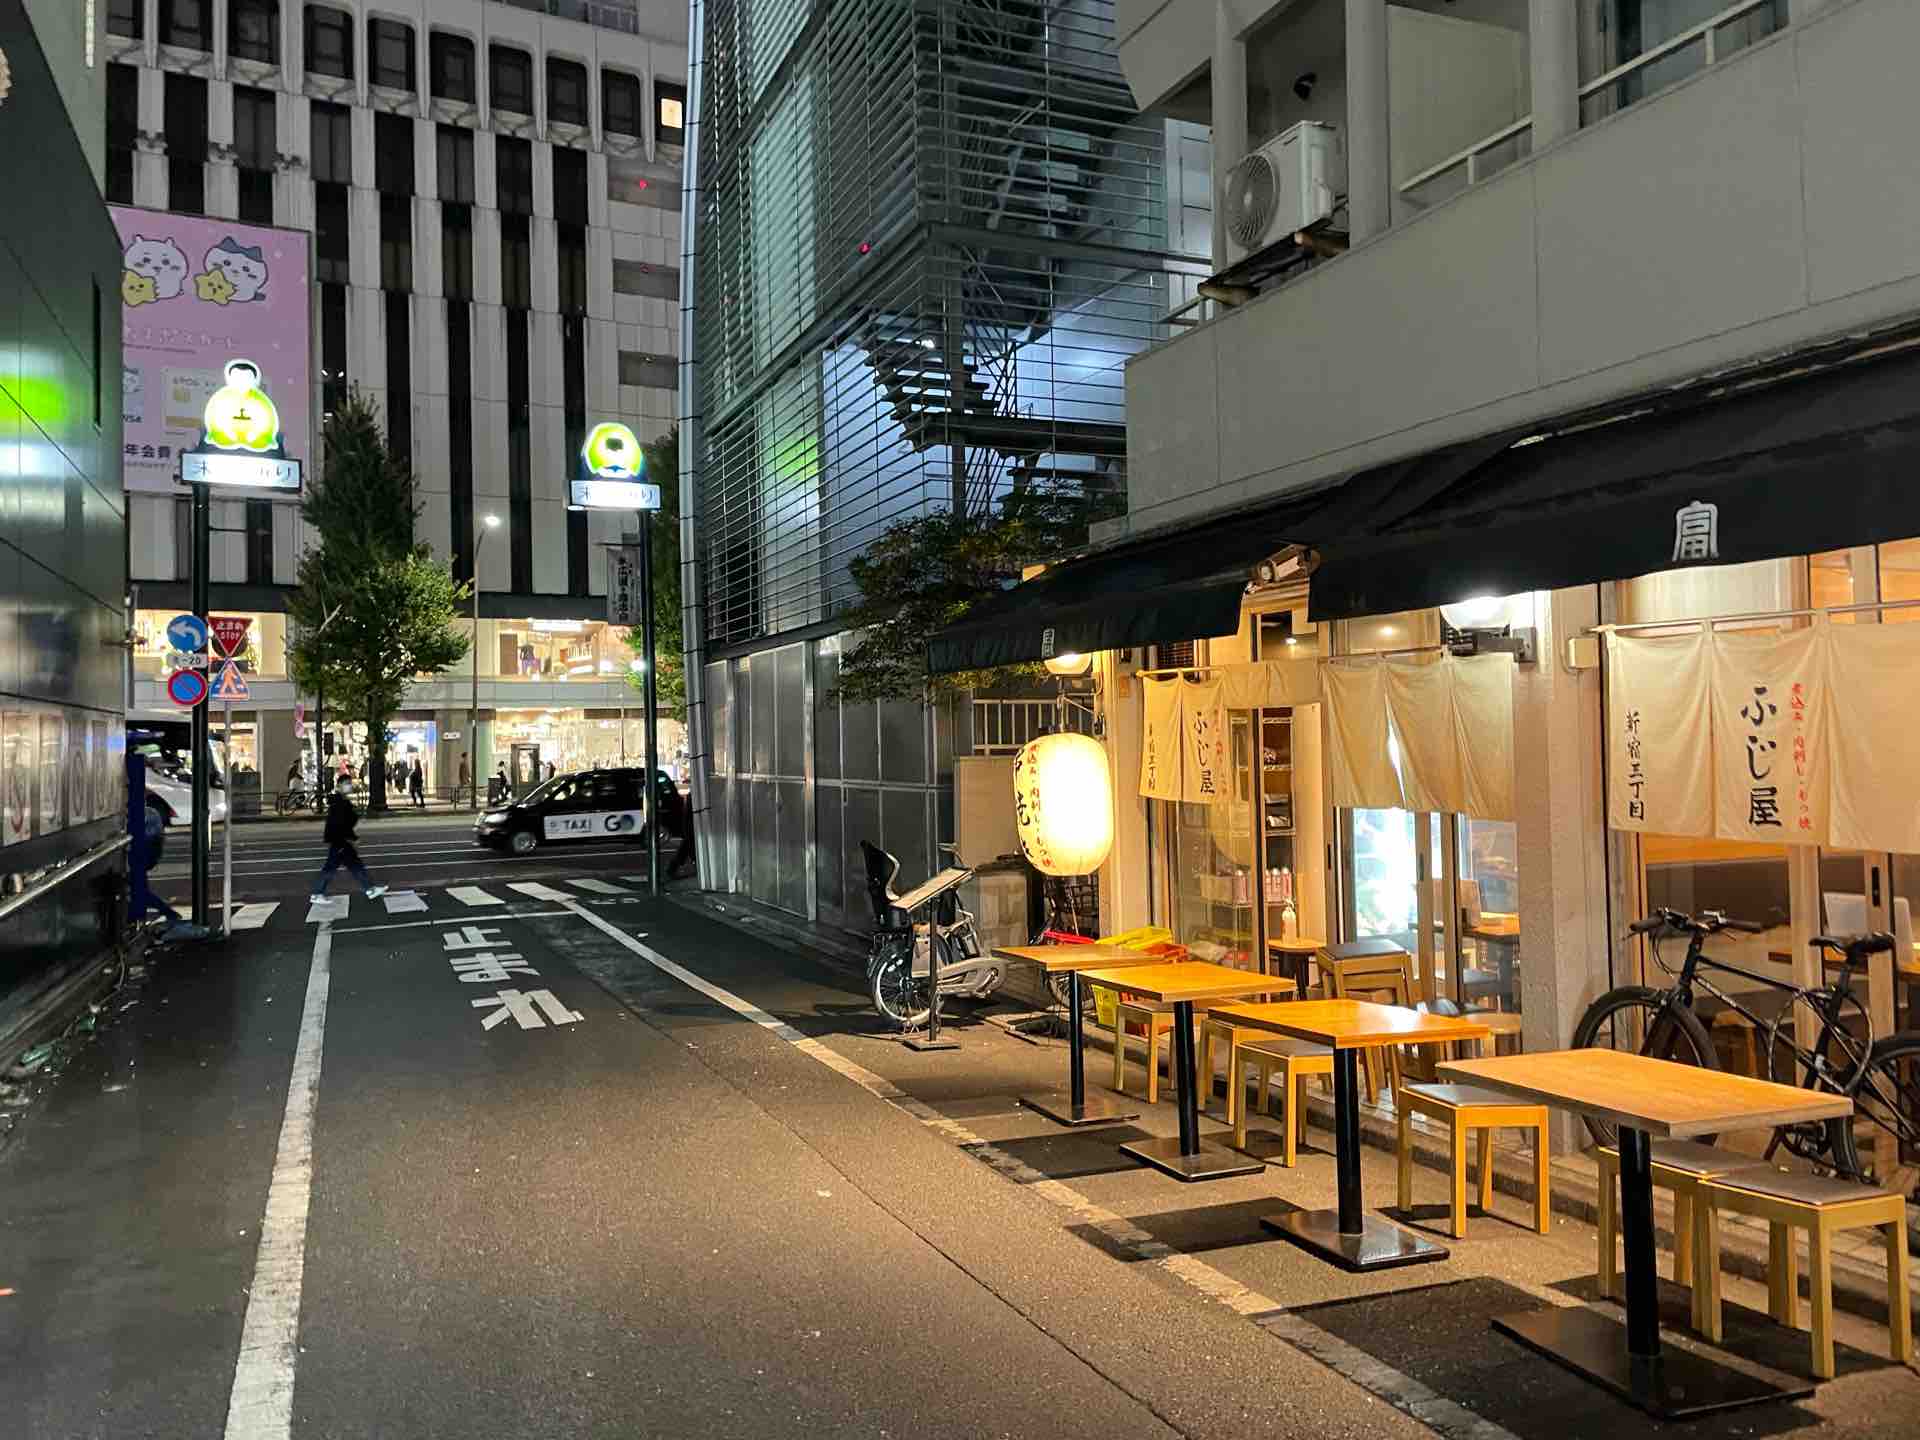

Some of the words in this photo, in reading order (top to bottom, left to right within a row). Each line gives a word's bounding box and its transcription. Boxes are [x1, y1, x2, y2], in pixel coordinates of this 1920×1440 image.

[220, 631, 241, 640] STOP
[1193, 711, 1216, 794] ふじ屋
[1624, 710, 1644, 821] 新宿三丁目
[1740, 686, 1782, 826] ふじ屋
[562, 818, 592, 830] TAXI
[604, 814, 635, 832] GO
[442, 926, 585, 1030] 止まれ
